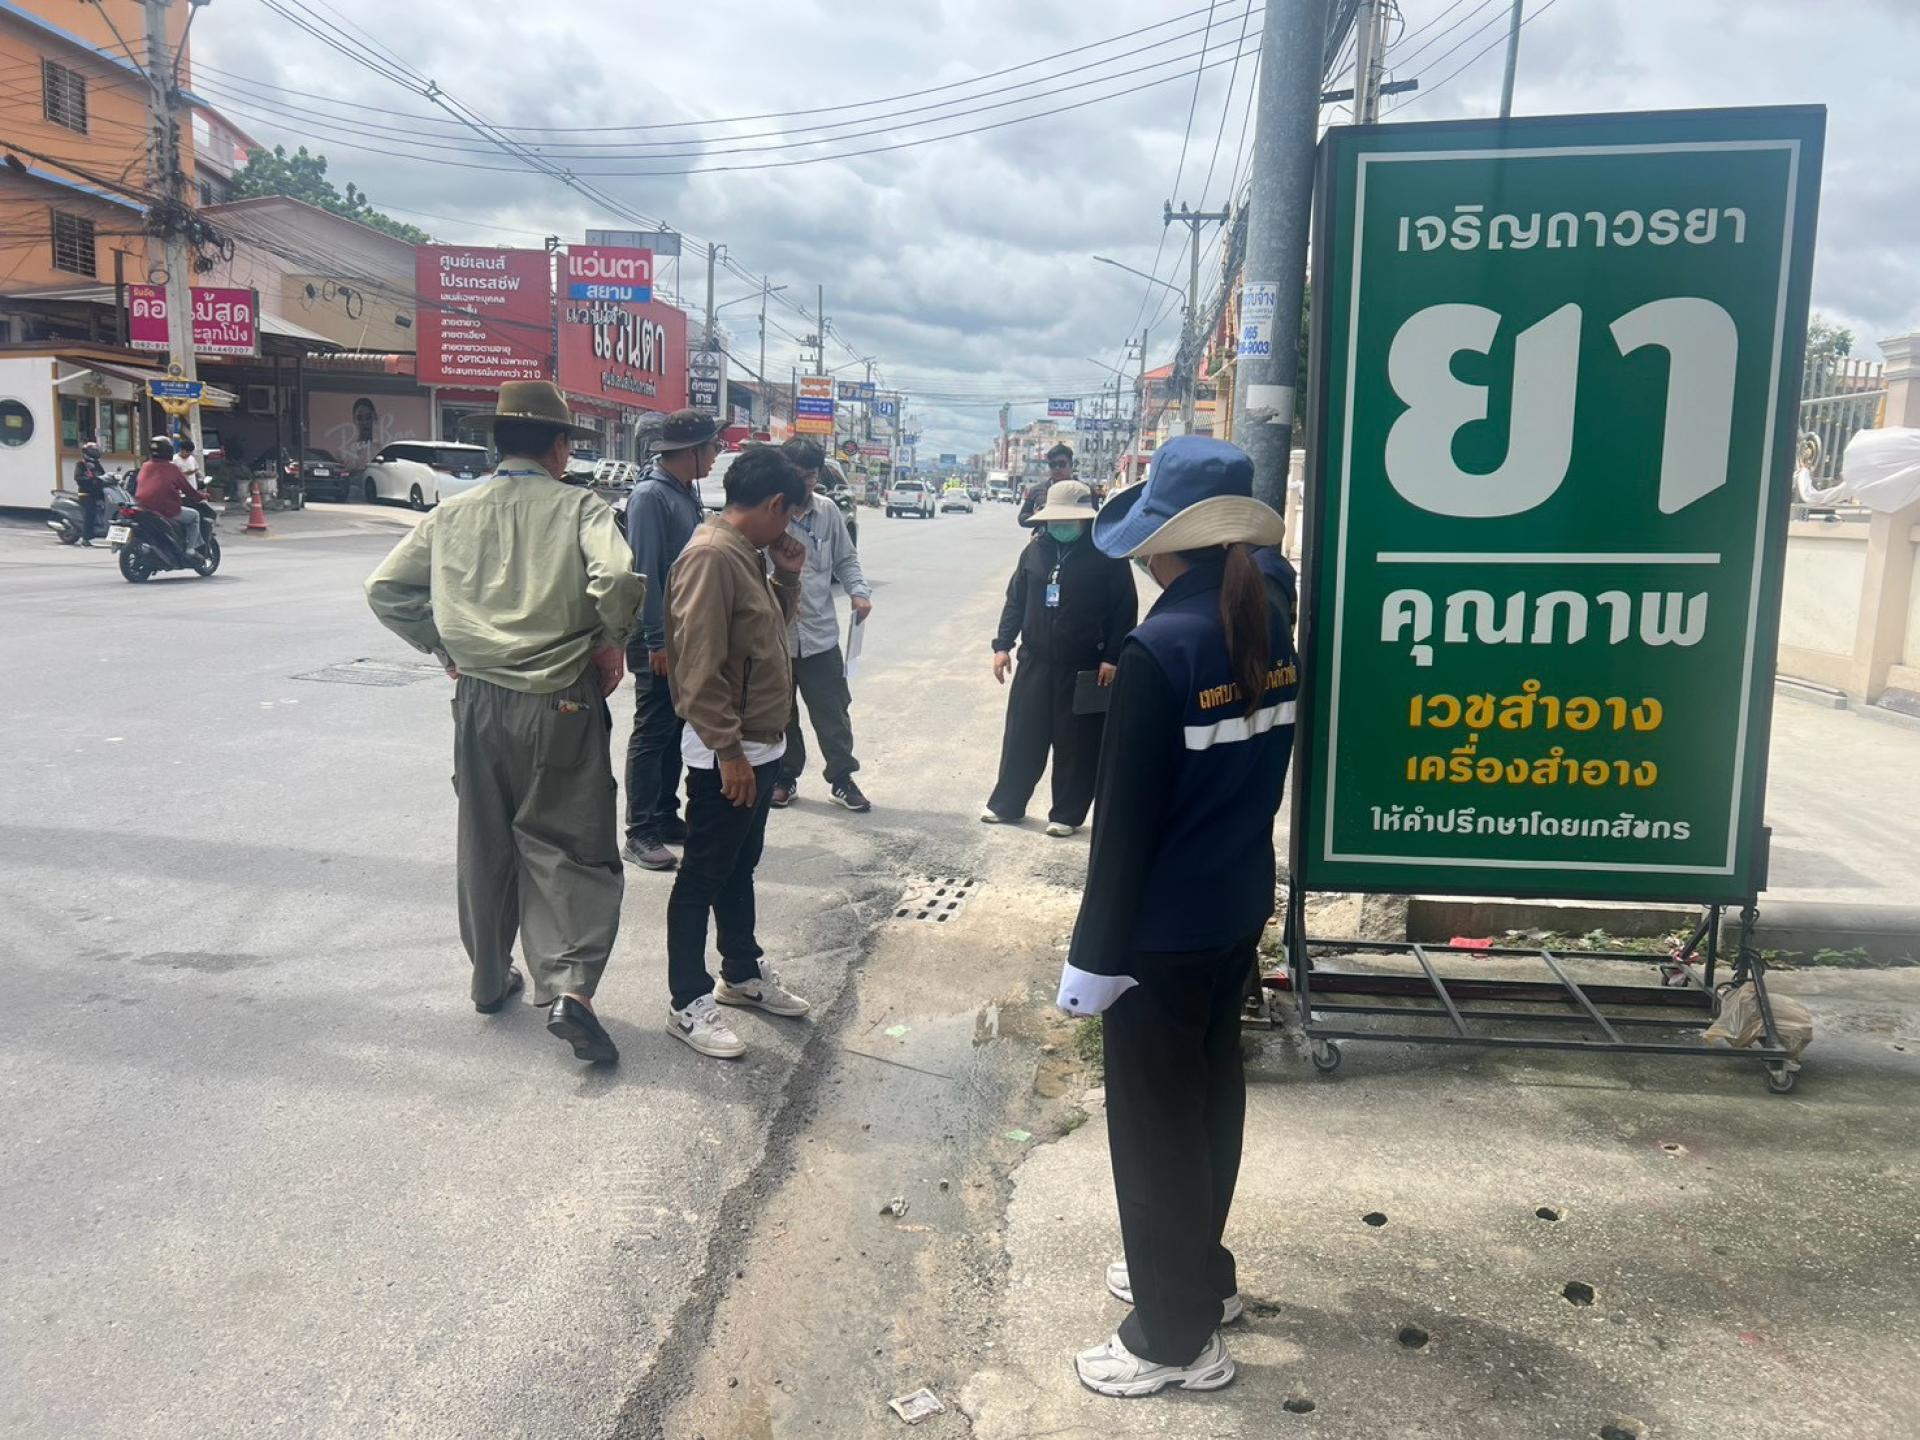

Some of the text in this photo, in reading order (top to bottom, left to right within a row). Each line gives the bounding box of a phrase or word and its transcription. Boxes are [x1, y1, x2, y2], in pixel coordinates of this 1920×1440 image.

[1397, 204, 1748, 252] เจริญถาวรยา
[440, 253, 506, 270] ศูนย์เลนส์
[569, 250, 650, 280] แว่นตา
[440, 272, 520, 290] โปรเกรสซีฟ
[586, 285, 633, 300] สยาม
[133, 292, 250, 323] ดอม้สด
[441, 354, 454, 364] BY
[457, 354, 499, 365] OPTICIAN
[1384, 296, 1739, 518] ยา
[1380, 588, 1709, 667] คุณภาพ
[1408, 678, 1664, 732] เวชสำอาง
[1405, 733, 1658, 788] เครื่องสำอาง
[1369, 805, 1691, 841] ให้คำปรึกษาโดยเภสัชกร
